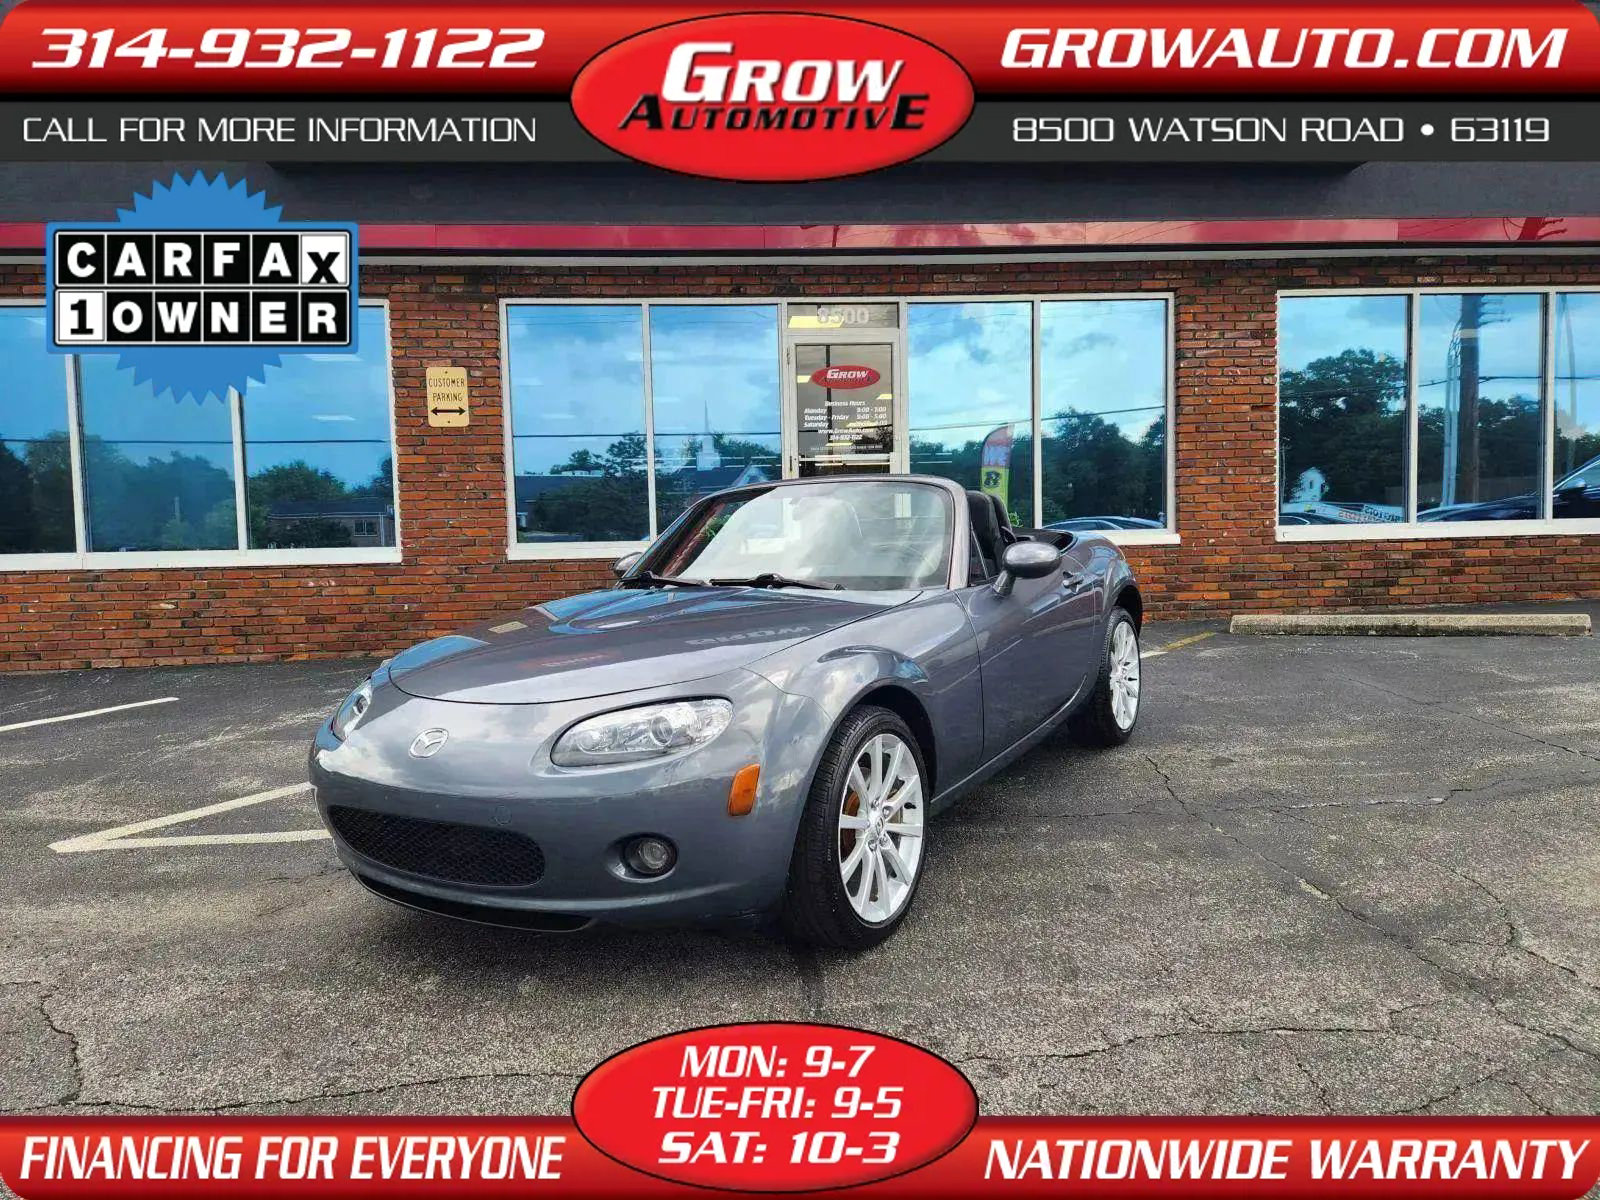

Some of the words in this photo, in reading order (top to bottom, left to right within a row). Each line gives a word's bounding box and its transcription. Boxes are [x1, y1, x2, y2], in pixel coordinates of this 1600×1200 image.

[817, 307, 870, 325] 8500
[826, 368, 869, 379] GROW
[428, 377, 465, 388] CUSTOMER
[432, 392, 463, 402] PARKING
